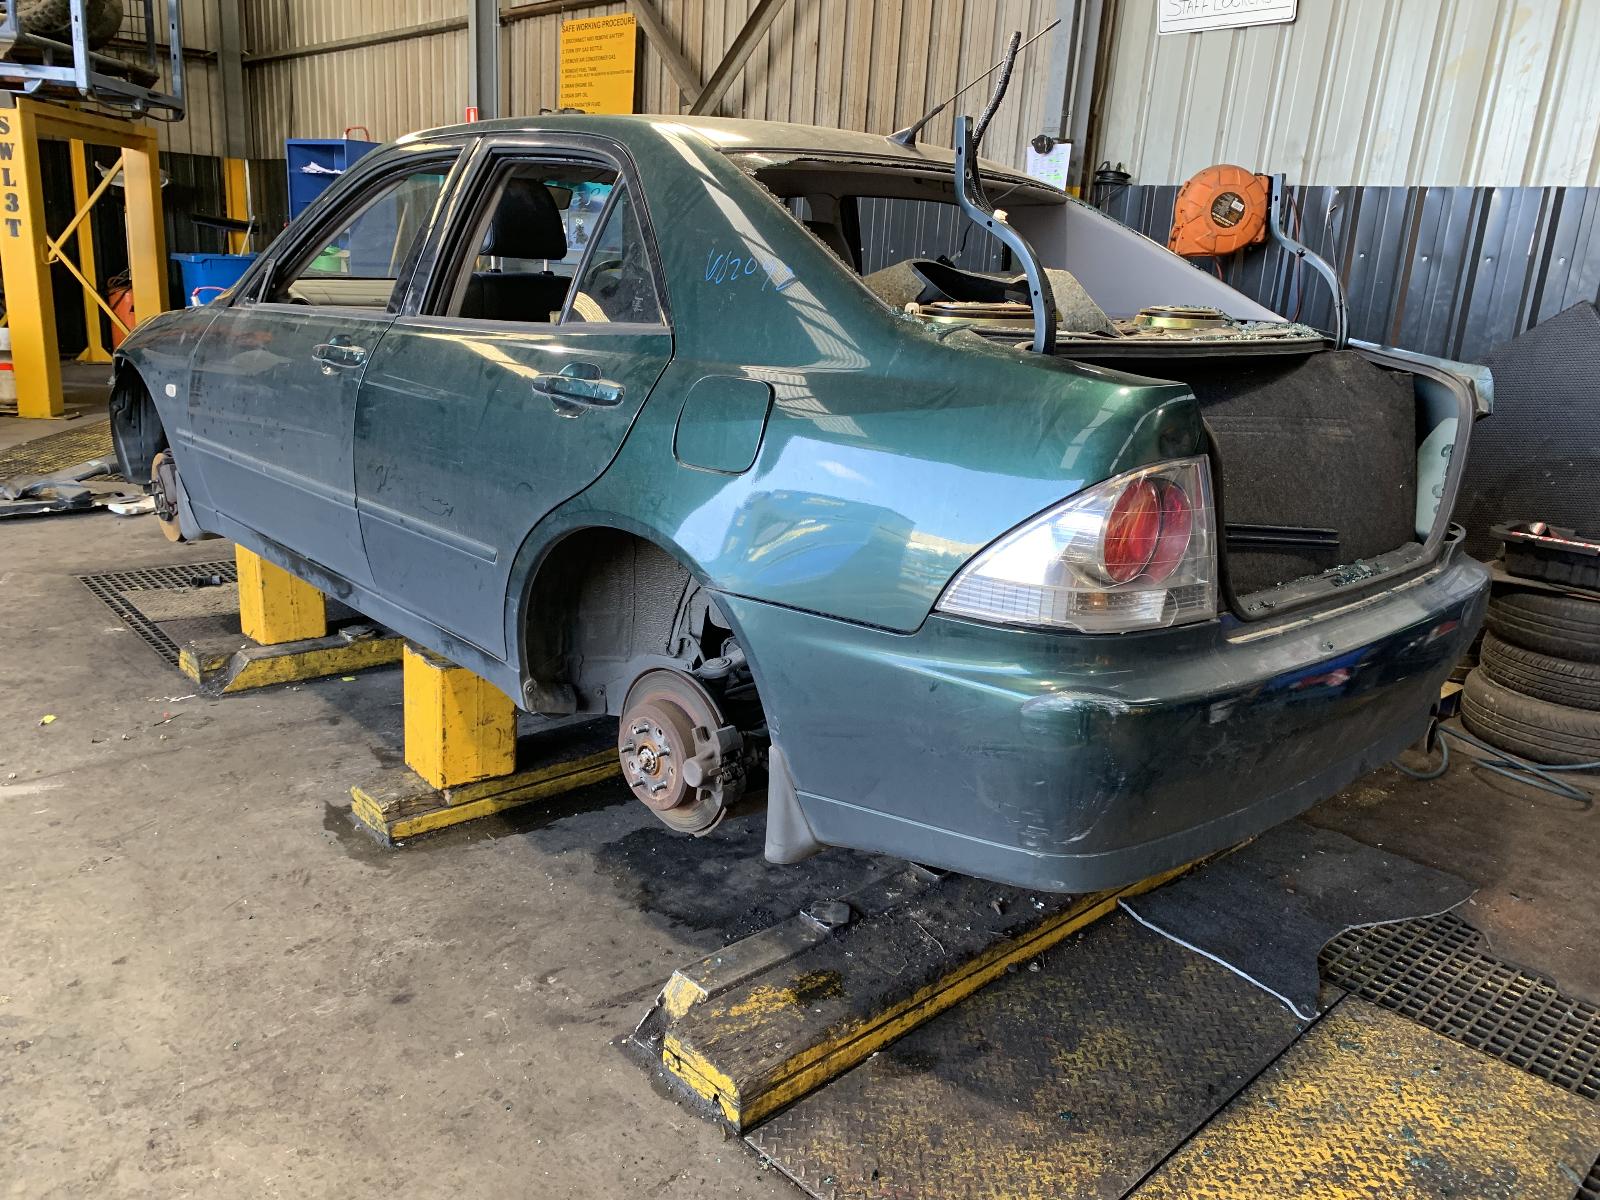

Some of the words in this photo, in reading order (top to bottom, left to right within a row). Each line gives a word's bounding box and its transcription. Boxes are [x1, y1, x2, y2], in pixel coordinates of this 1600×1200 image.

[562, 24, 576, 33] SAFE
[576, 21, 601, 31] WORKING
[602, 16, 635, 28] PROCEDURE
